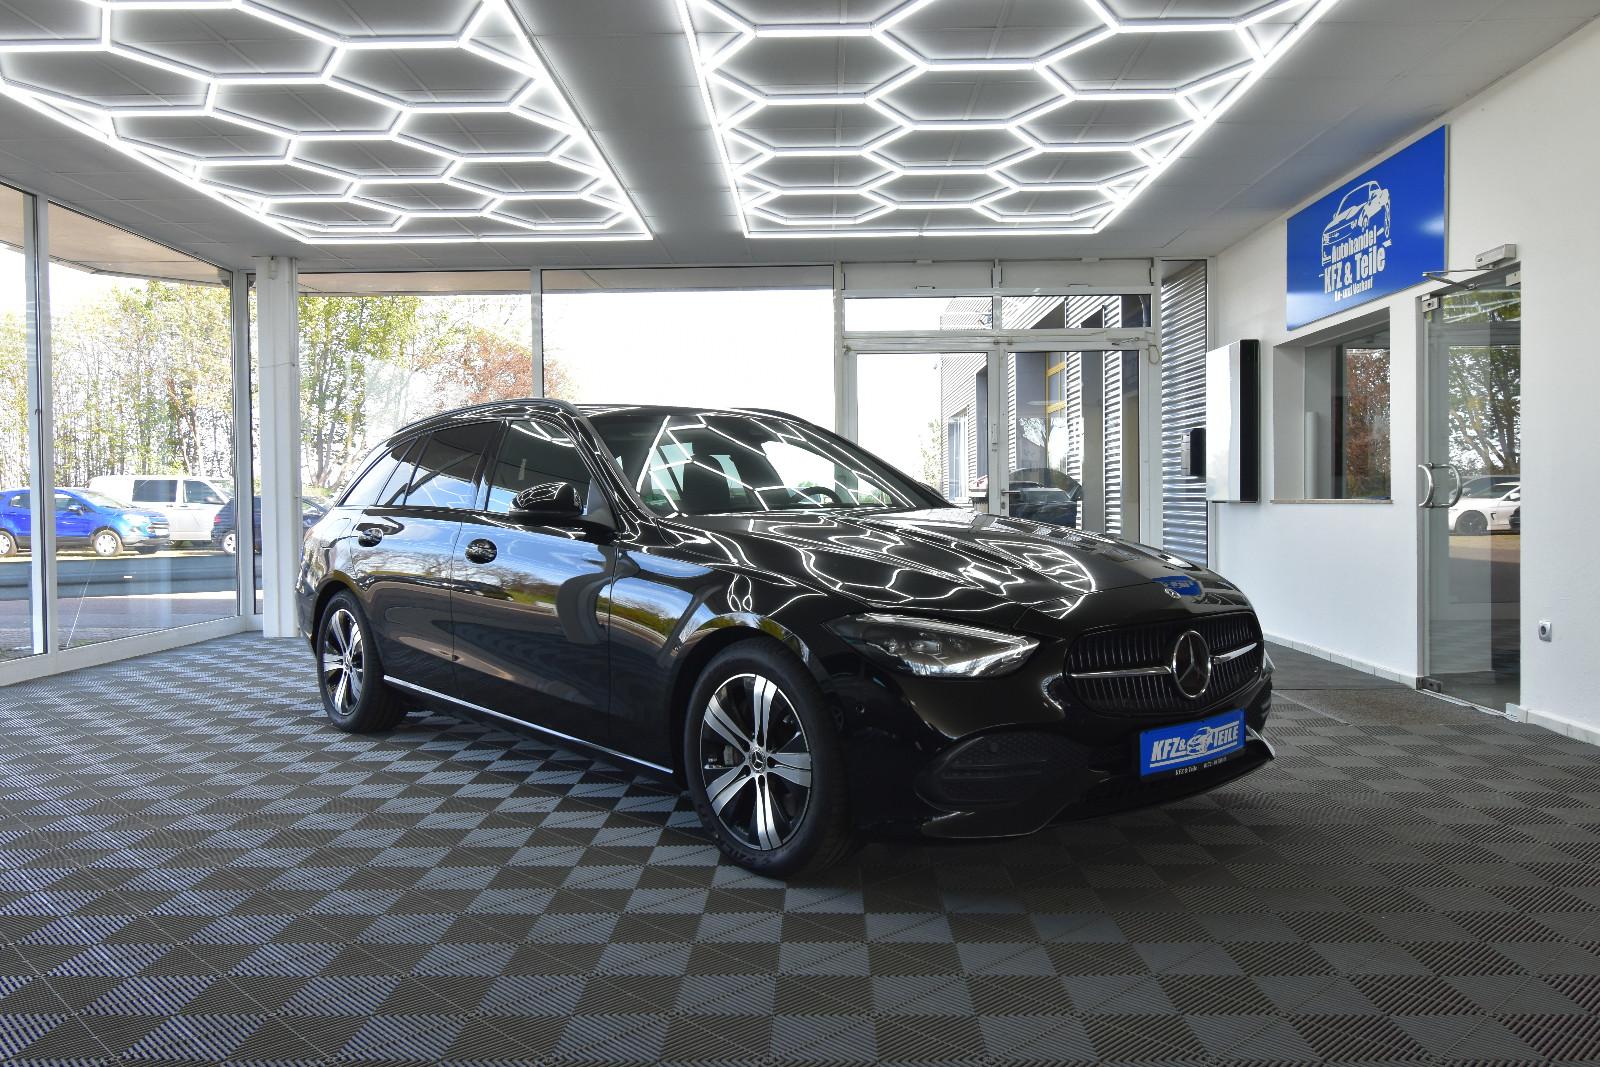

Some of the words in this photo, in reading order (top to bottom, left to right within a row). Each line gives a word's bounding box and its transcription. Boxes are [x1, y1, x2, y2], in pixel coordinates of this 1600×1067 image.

[1331, 225, 1377, 264] Autohandel
[1324, 262, 1343, 294] KFZ
[1344, 262, 1353, 286] &
[1355, 246, 1386, 281] Teile
[1213, 725, 1239, 748] TEILE
